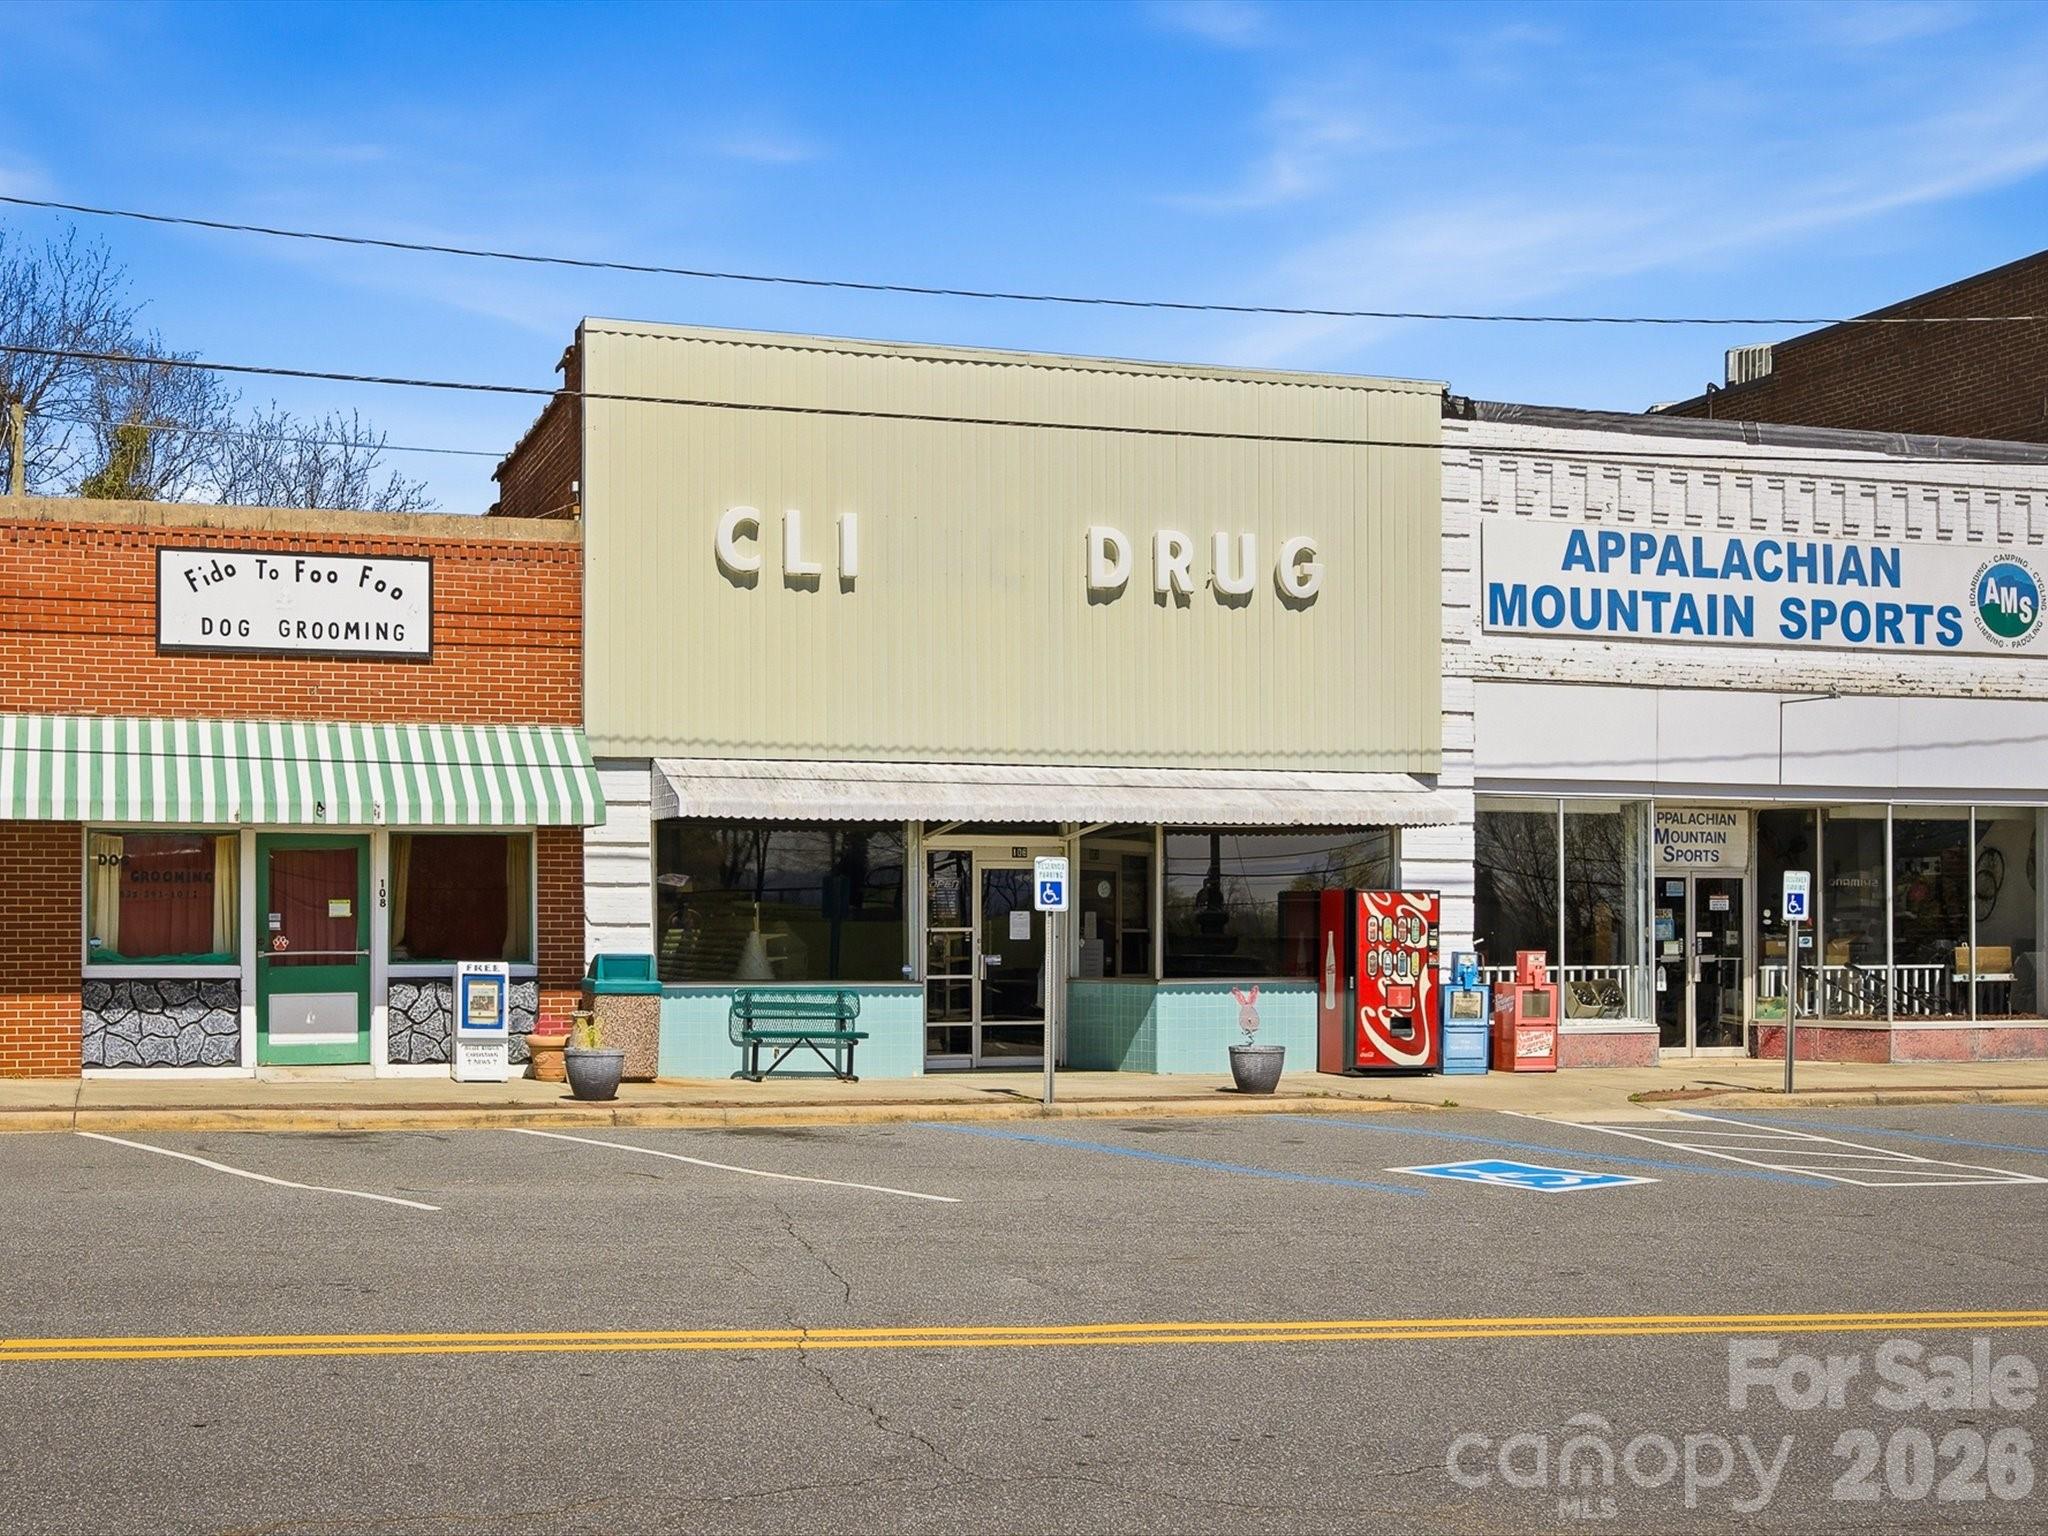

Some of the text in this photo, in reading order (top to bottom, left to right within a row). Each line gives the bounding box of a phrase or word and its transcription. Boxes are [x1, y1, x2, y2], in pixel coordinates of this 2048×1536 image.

[715, 506, 1325, 598] CLI DRUG
[1561, 529, 1900, 588] APPALACHIAN
[1993, 554, 2028, 568] CAMPING
[184, 559, 403, 600] Fido To Foo Foo
[1969, 562, 1988, 607] BOARDING
[2032, 571, 2047, 611] CYCLING
[1984, 576, 2033, 624] AMS
[201, 617, 405, 641] DOG GROOMING
[1489, 582, 1964, 649] MOUNTAIN SPORTS
[1974, 616, 2004, 648] CLIMBING
[2011, 621, 2043, 648] PADDLING
[1655, 811, 1737, 826] PPALACHIAN
[1654, 827, 1727, 845] MOUNTAIN
[98, 854, 130, 866] DOG
[1663, 845, 1720, 862] SPORTS
[131, 870, 214, 883] GROOMING
[466, 964, 501, 972] FREE
